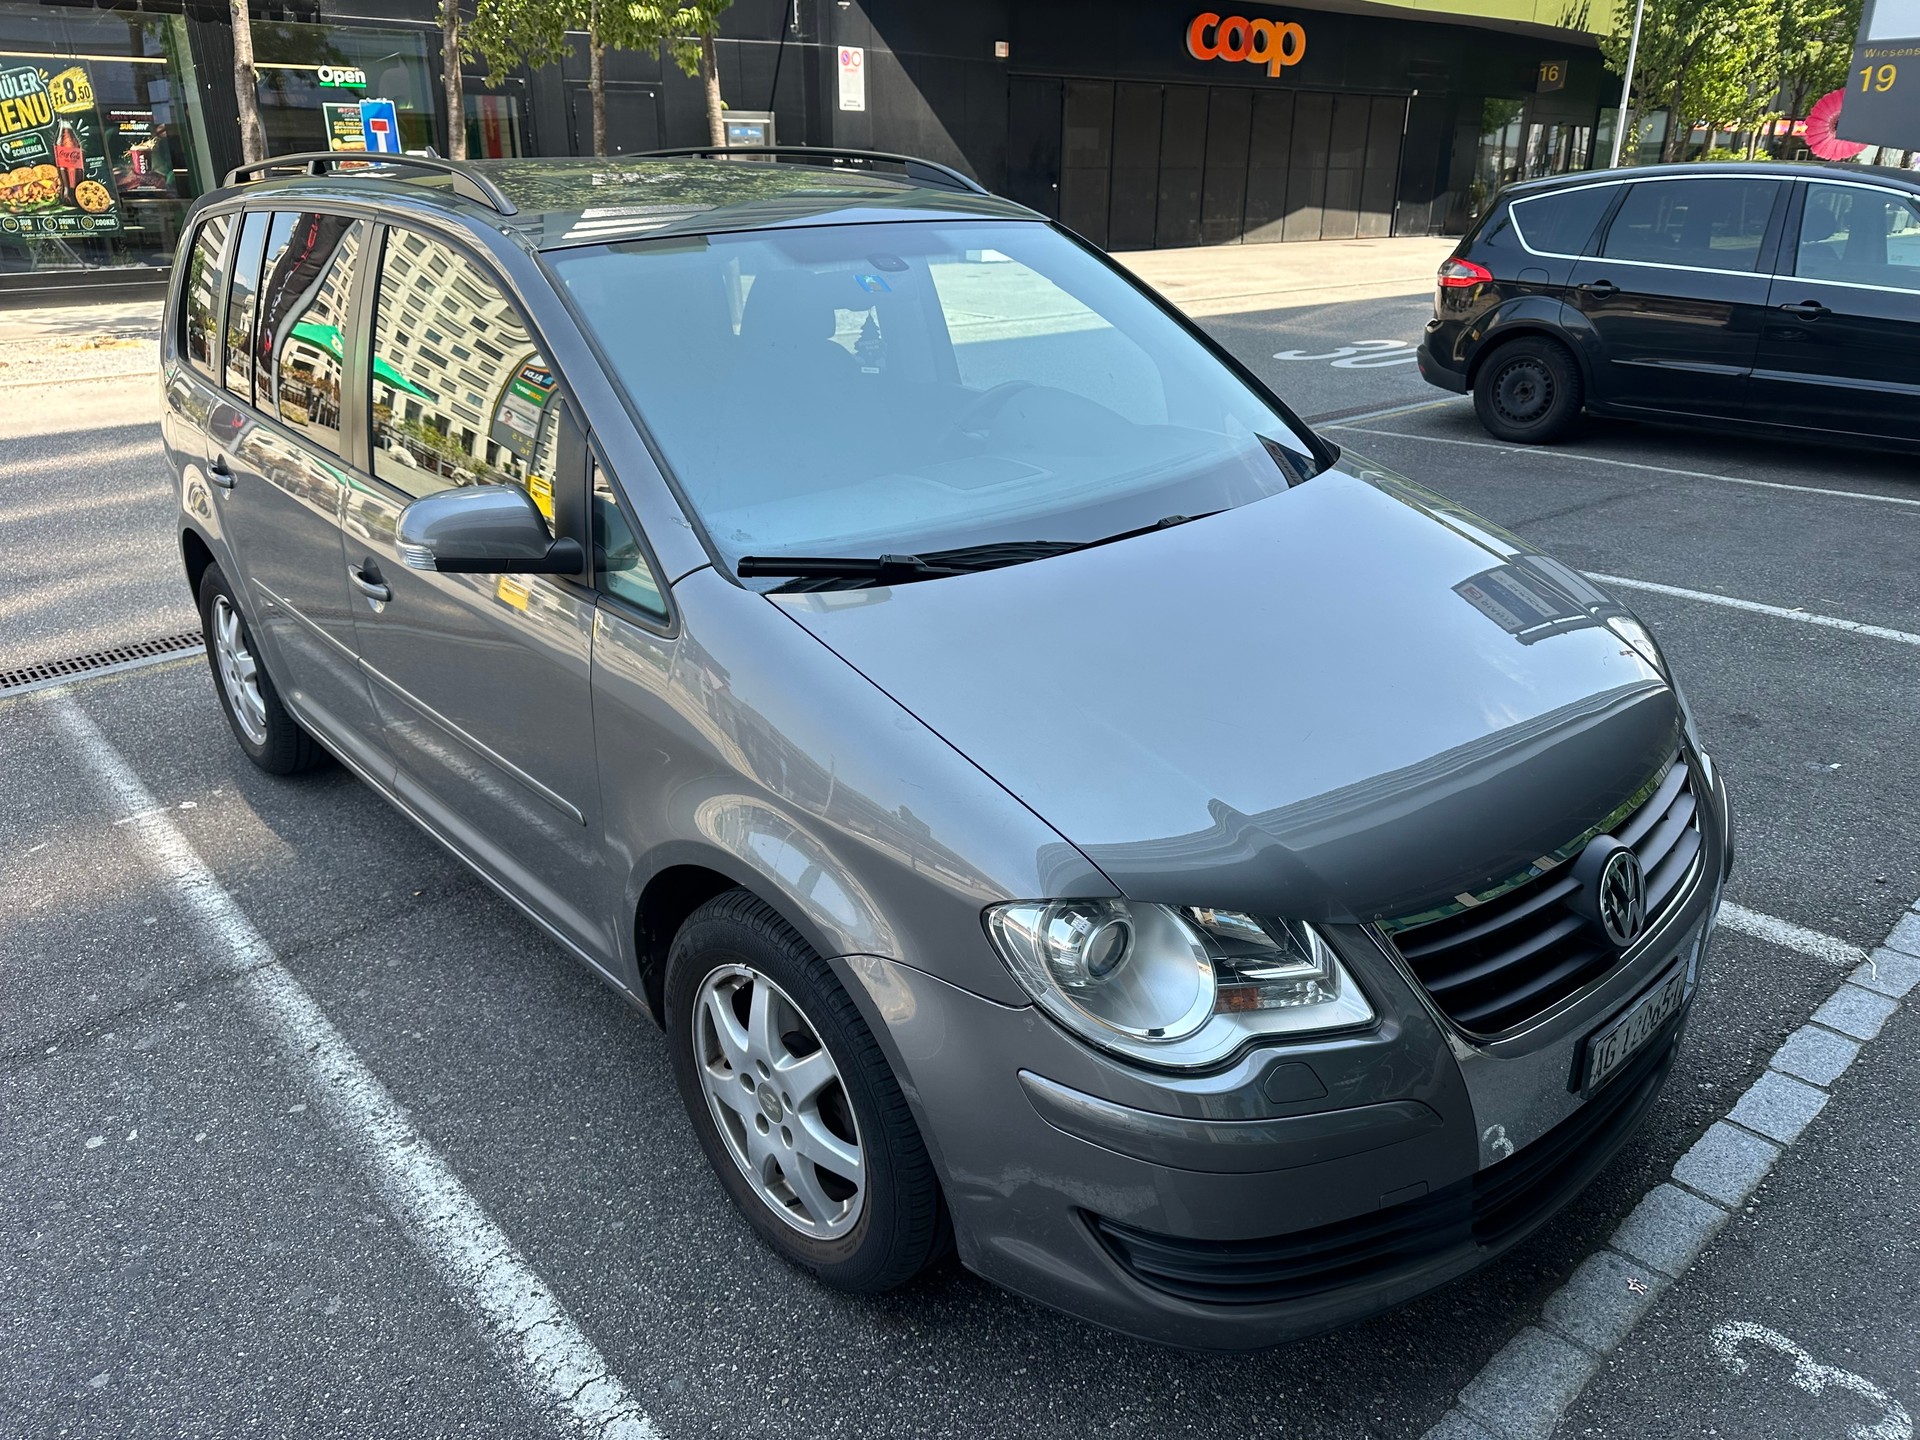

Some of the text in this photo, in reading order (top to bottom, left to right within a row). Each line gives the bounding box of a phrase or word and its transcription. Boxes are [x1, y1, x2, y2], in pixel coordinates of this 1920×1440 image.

[1187, 12, 1306, 77] coop
[318, 65, 366, 87] Open
[1540, 65, 1559, 81] 16
[1859, 64, 1897, 92] 19
[12, 144, 43, 157] SCHLIEREN
[95, 218, 116, 226] COOKIE
[1272, 339, 1418, 369] 30
